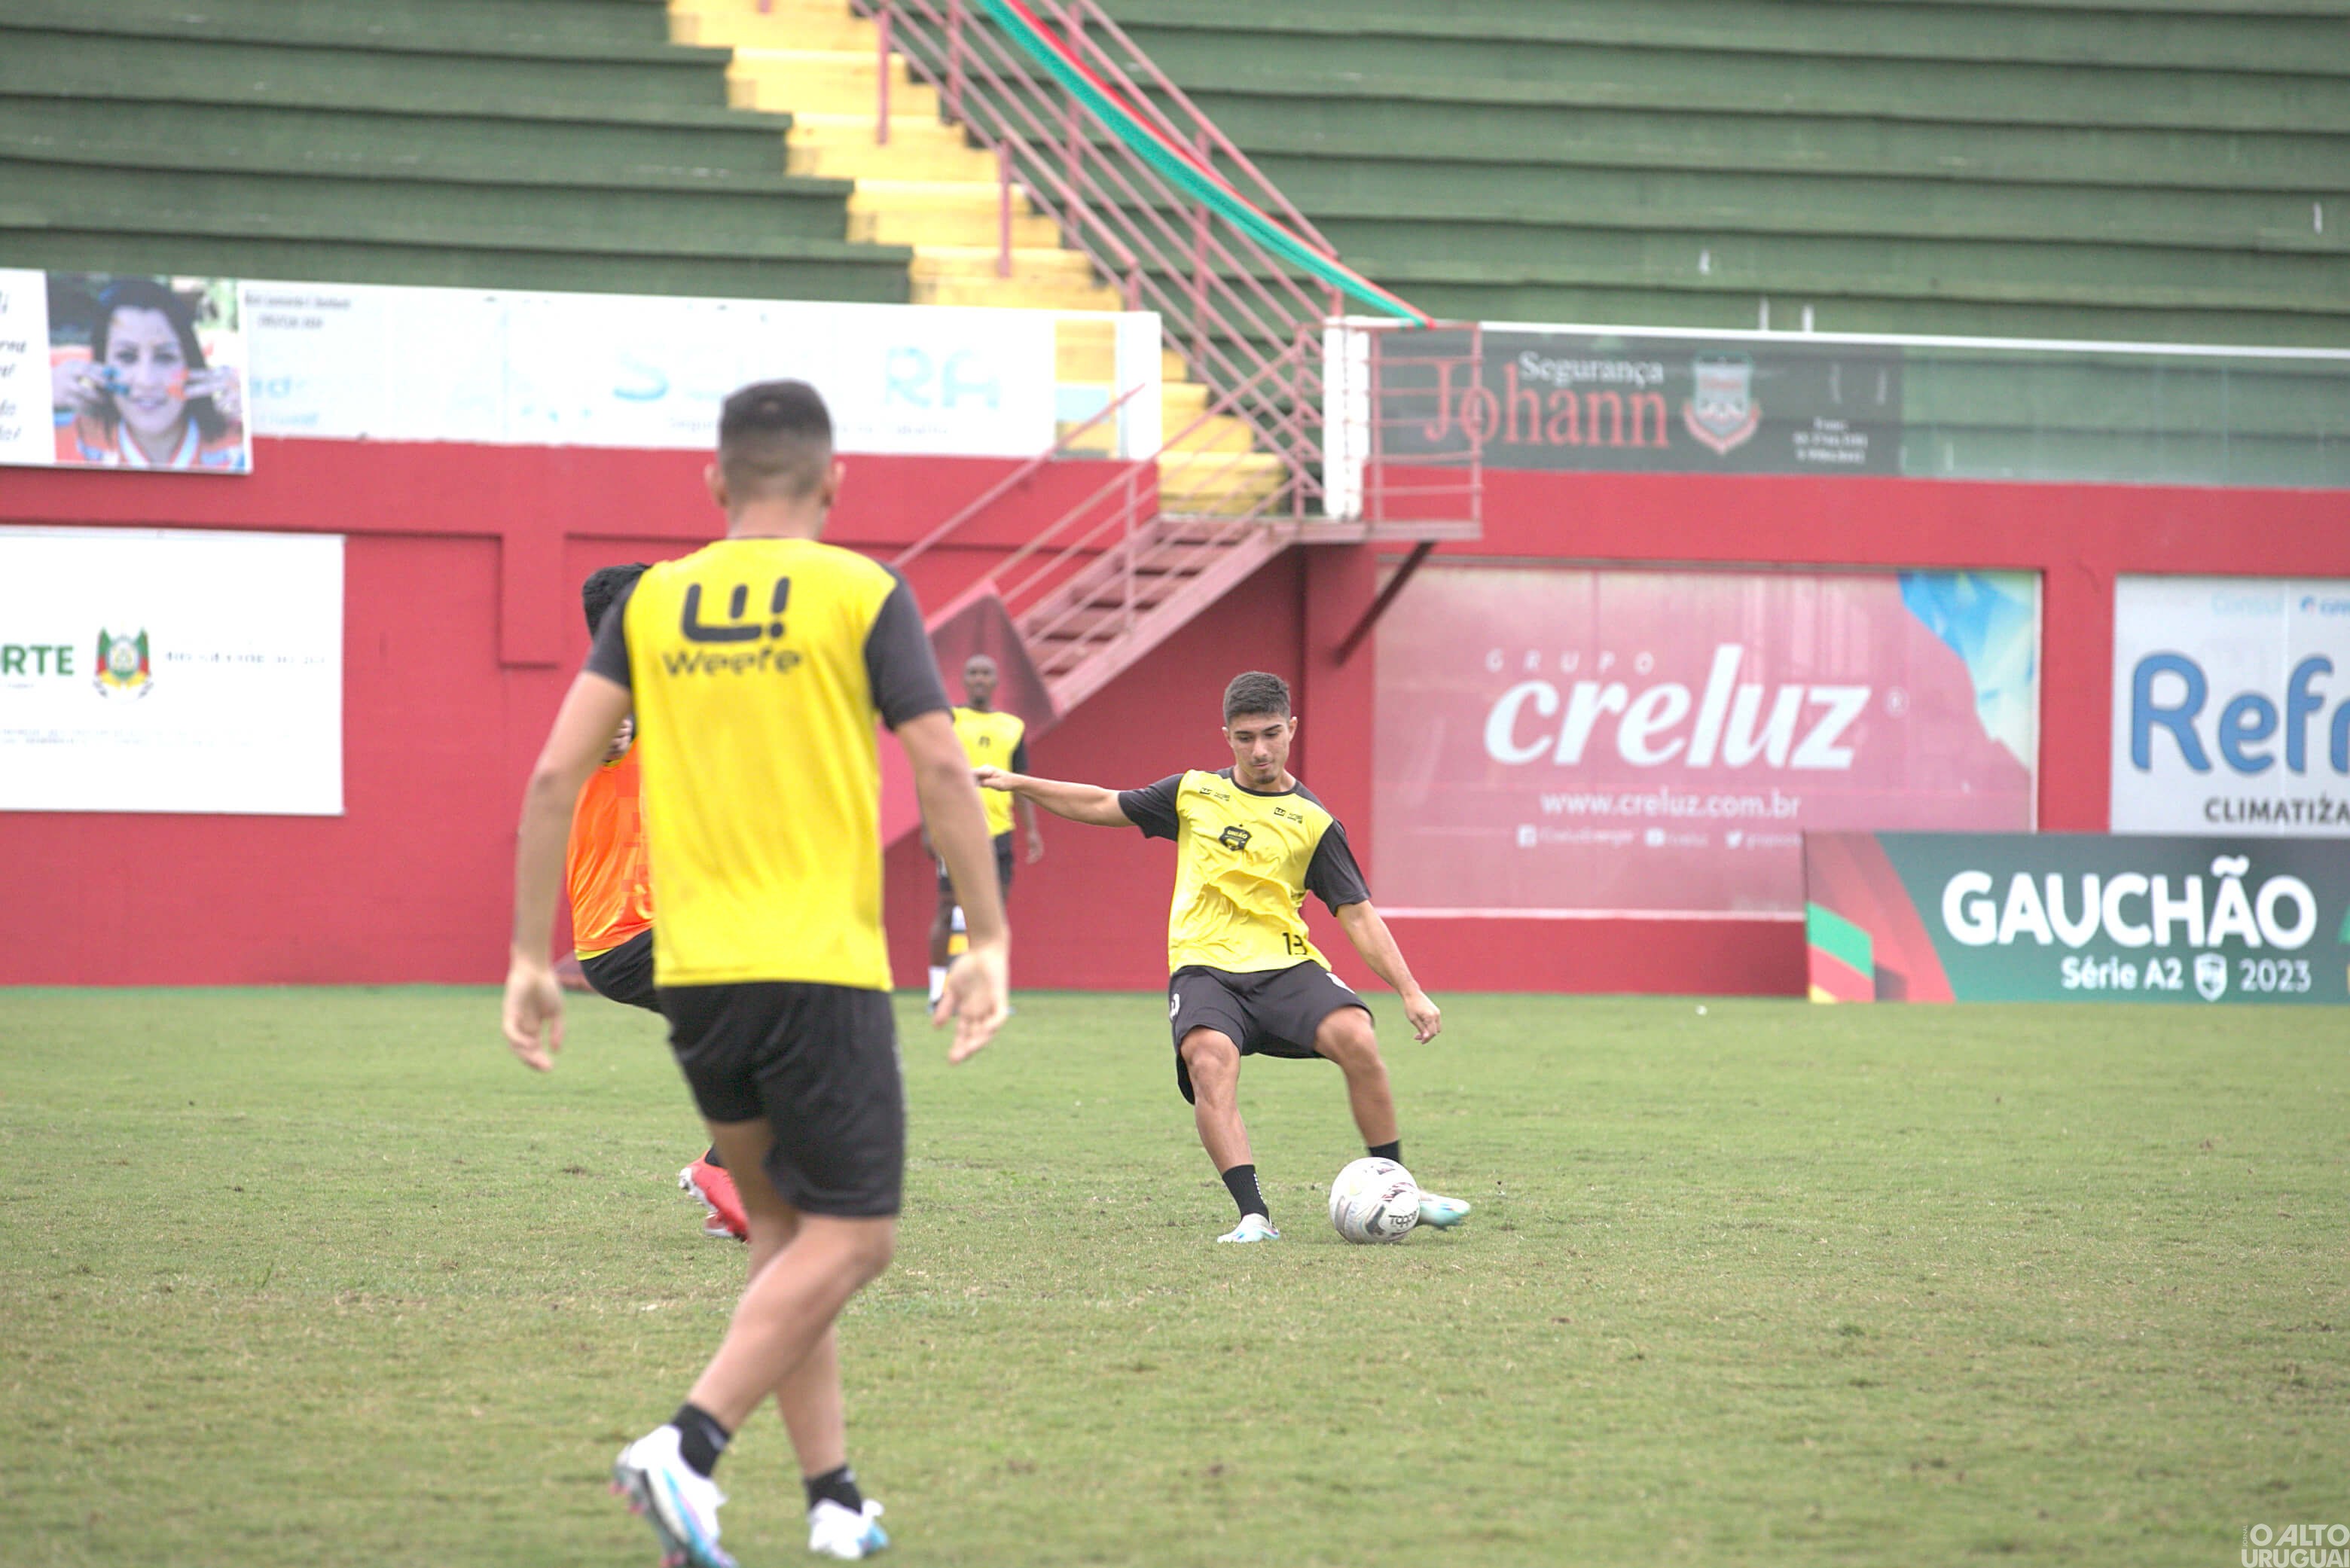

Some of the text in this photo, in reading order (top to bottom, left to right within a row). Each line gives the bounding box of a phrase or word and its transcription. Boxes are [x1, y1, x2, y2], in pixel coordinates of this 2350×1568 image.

[1517, 350, 1665, 389] Segurança
[1424, 359, 1671, 450] Johann
[1485, 650, 1656, 675] GRUPO
[1484, 644, 1872, 770] creluz
[1539, 786, 1803, 819] www.creluz.com.br
[1941, 854, 2318, 950] GAUCHÃO
[2060, 955, 2138, 990] Série
[2143, 957, 2184, 990] A2
[2239, 958, 2312, 993] 2023
